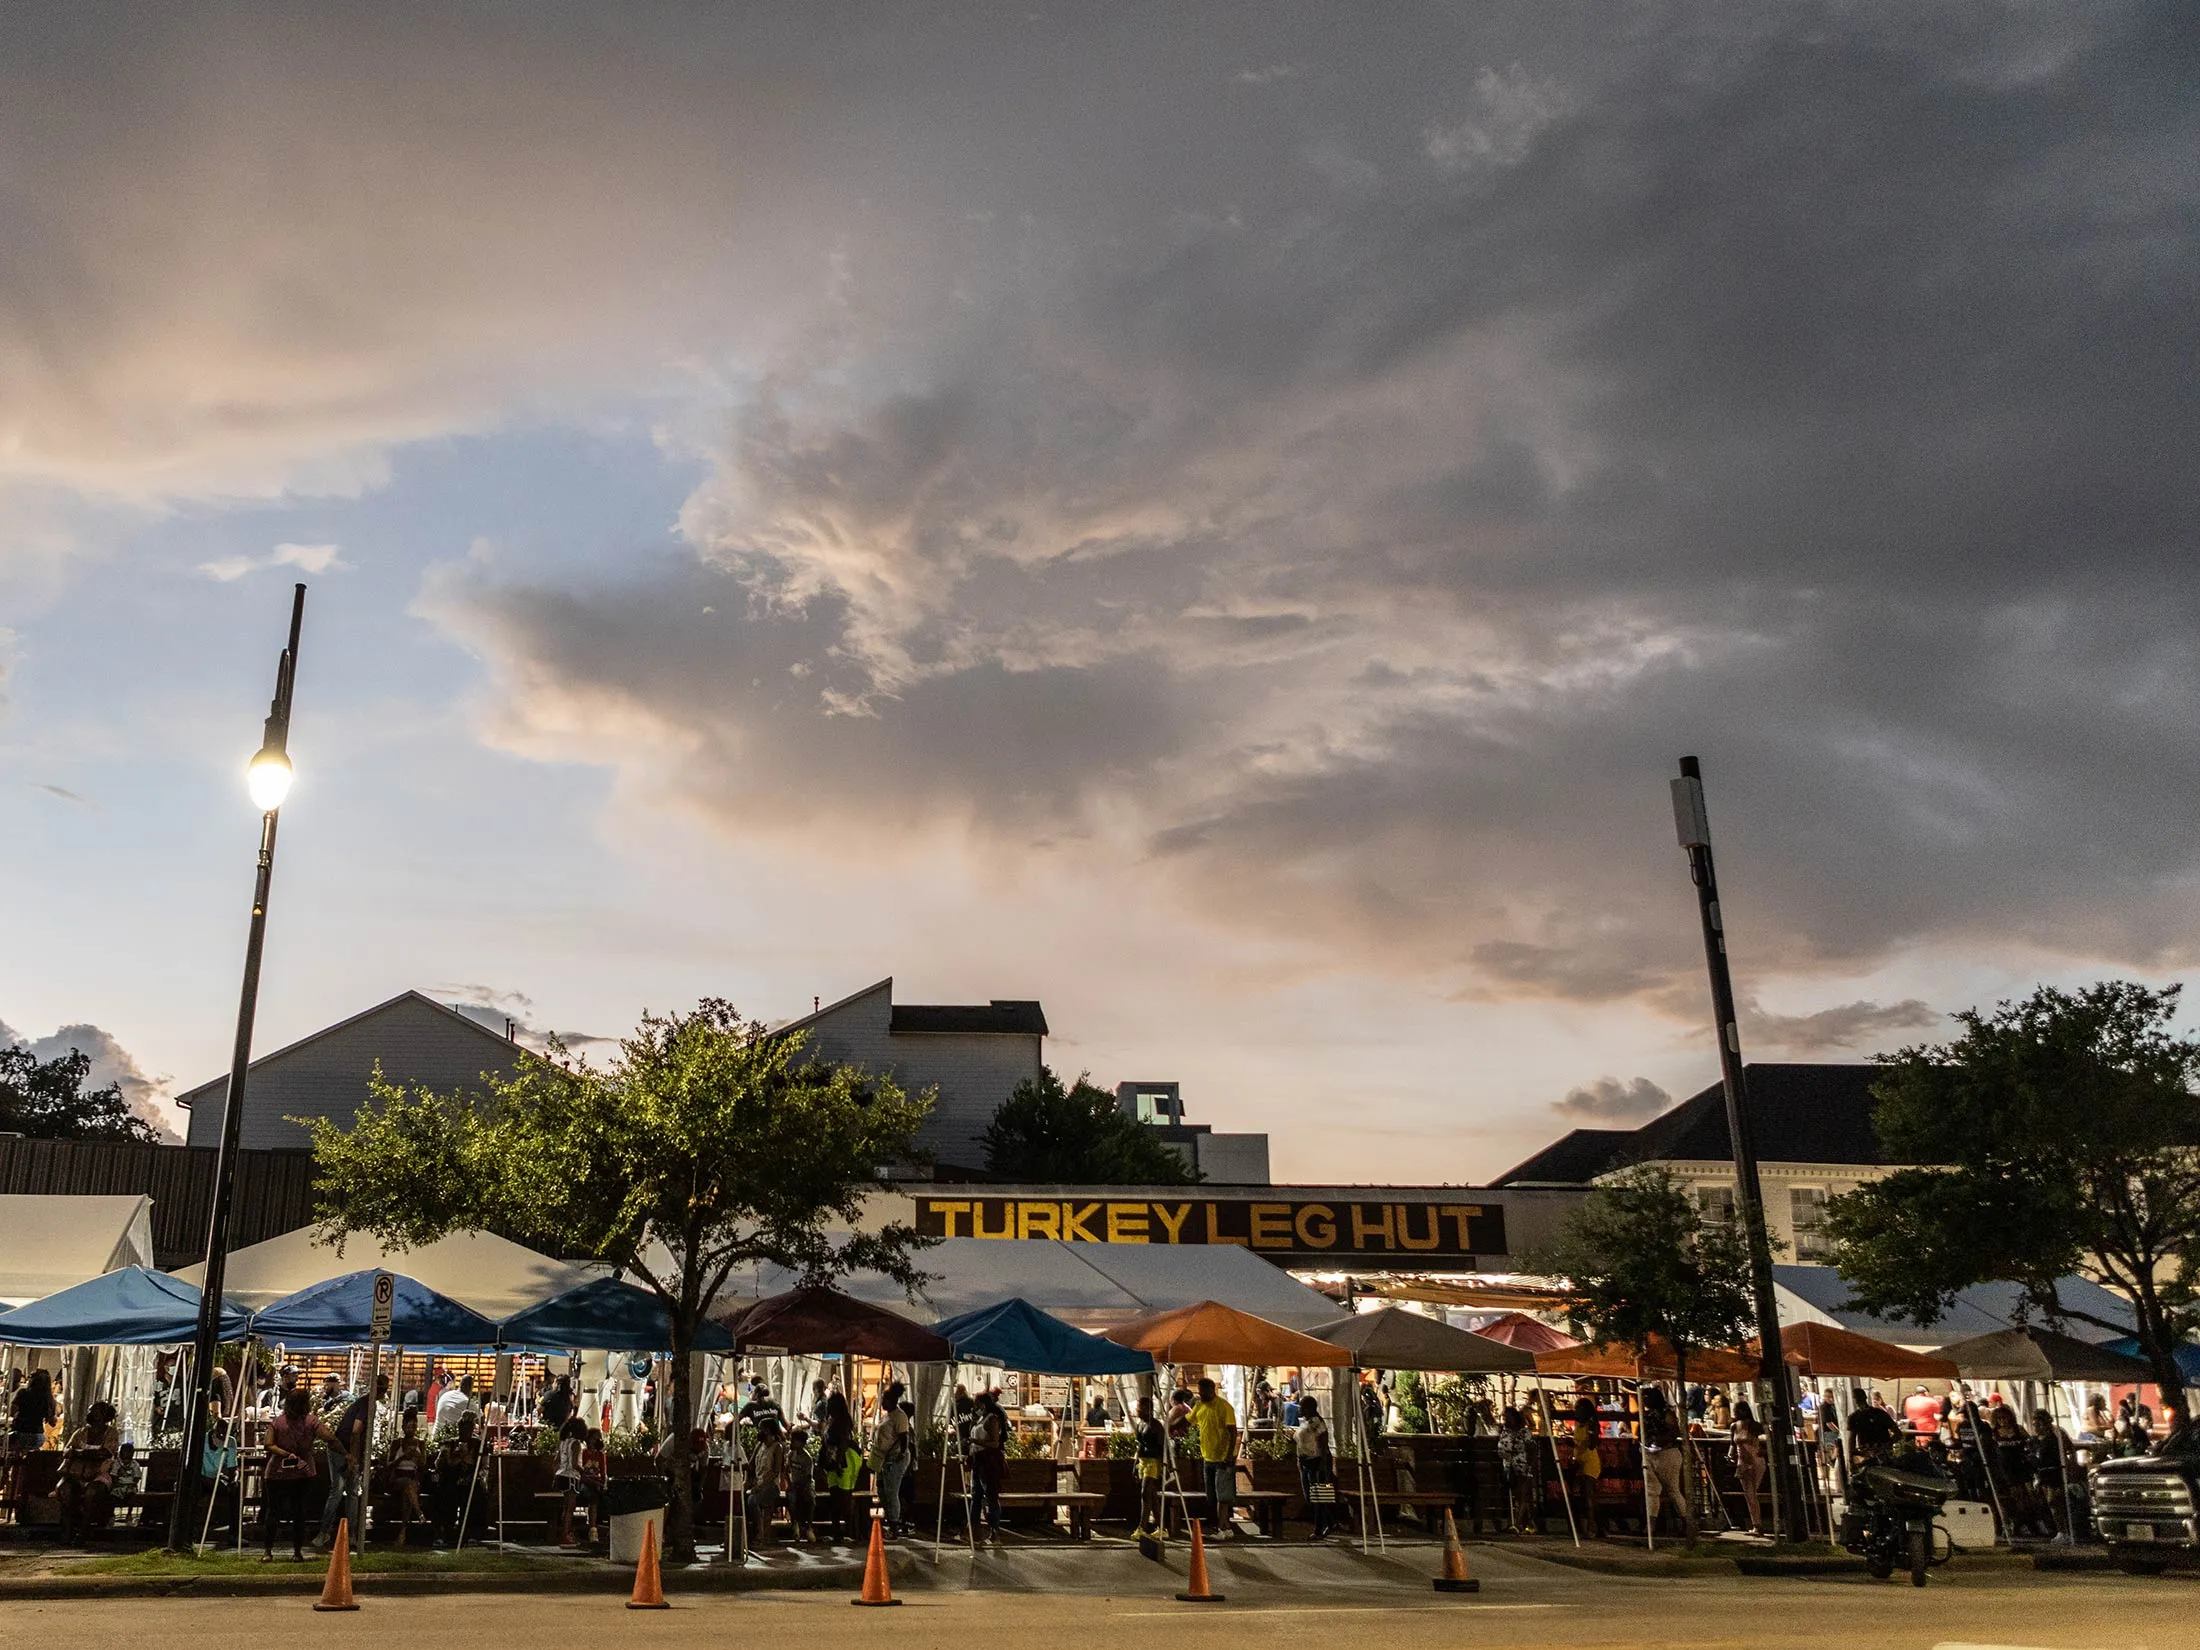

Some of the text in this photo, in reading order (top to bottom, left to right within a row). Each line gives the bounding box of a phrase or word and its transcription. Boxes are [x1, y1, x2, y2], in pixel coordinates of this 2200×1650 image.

[929, 1201, 1482, 1249] TURKEY LEG HUT
